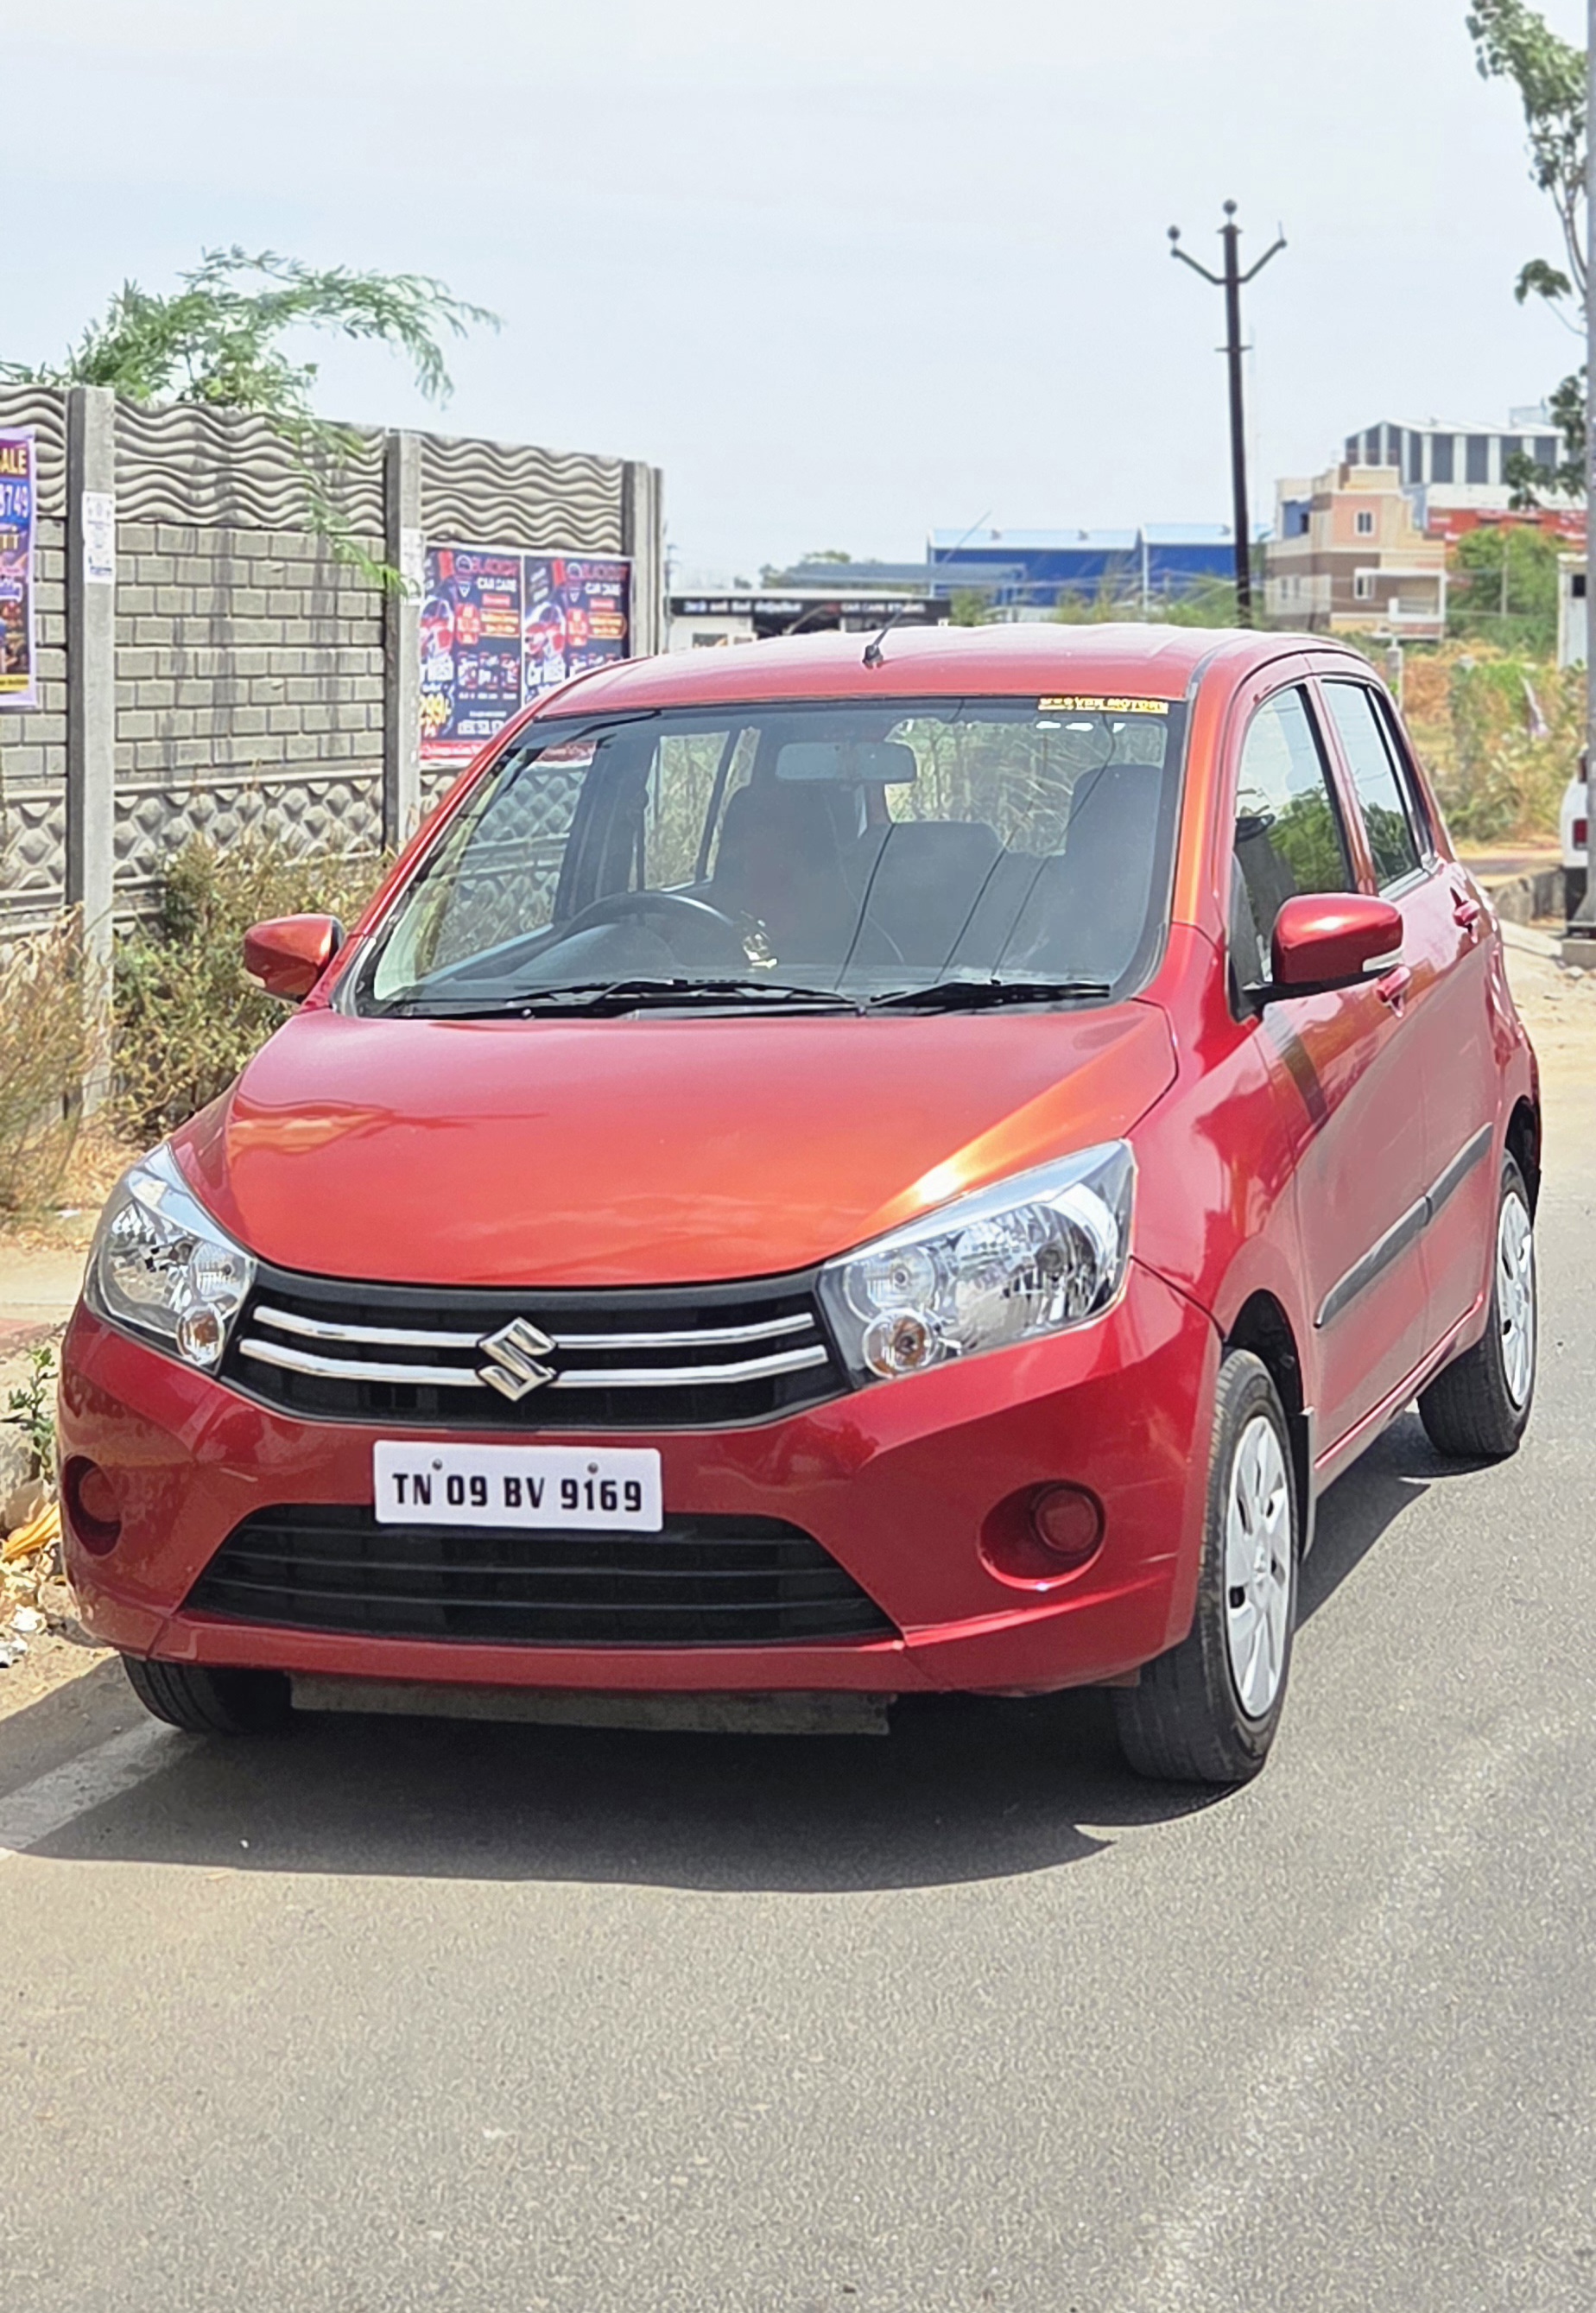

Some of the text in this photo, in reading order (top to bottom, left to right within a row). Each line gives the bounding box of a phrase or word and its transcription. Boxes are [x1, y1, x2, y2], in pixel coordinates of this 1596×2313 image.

[0, 447, 27, 475] ALE
[392, 1473, 642, 1512] TN 09 BV 9169
